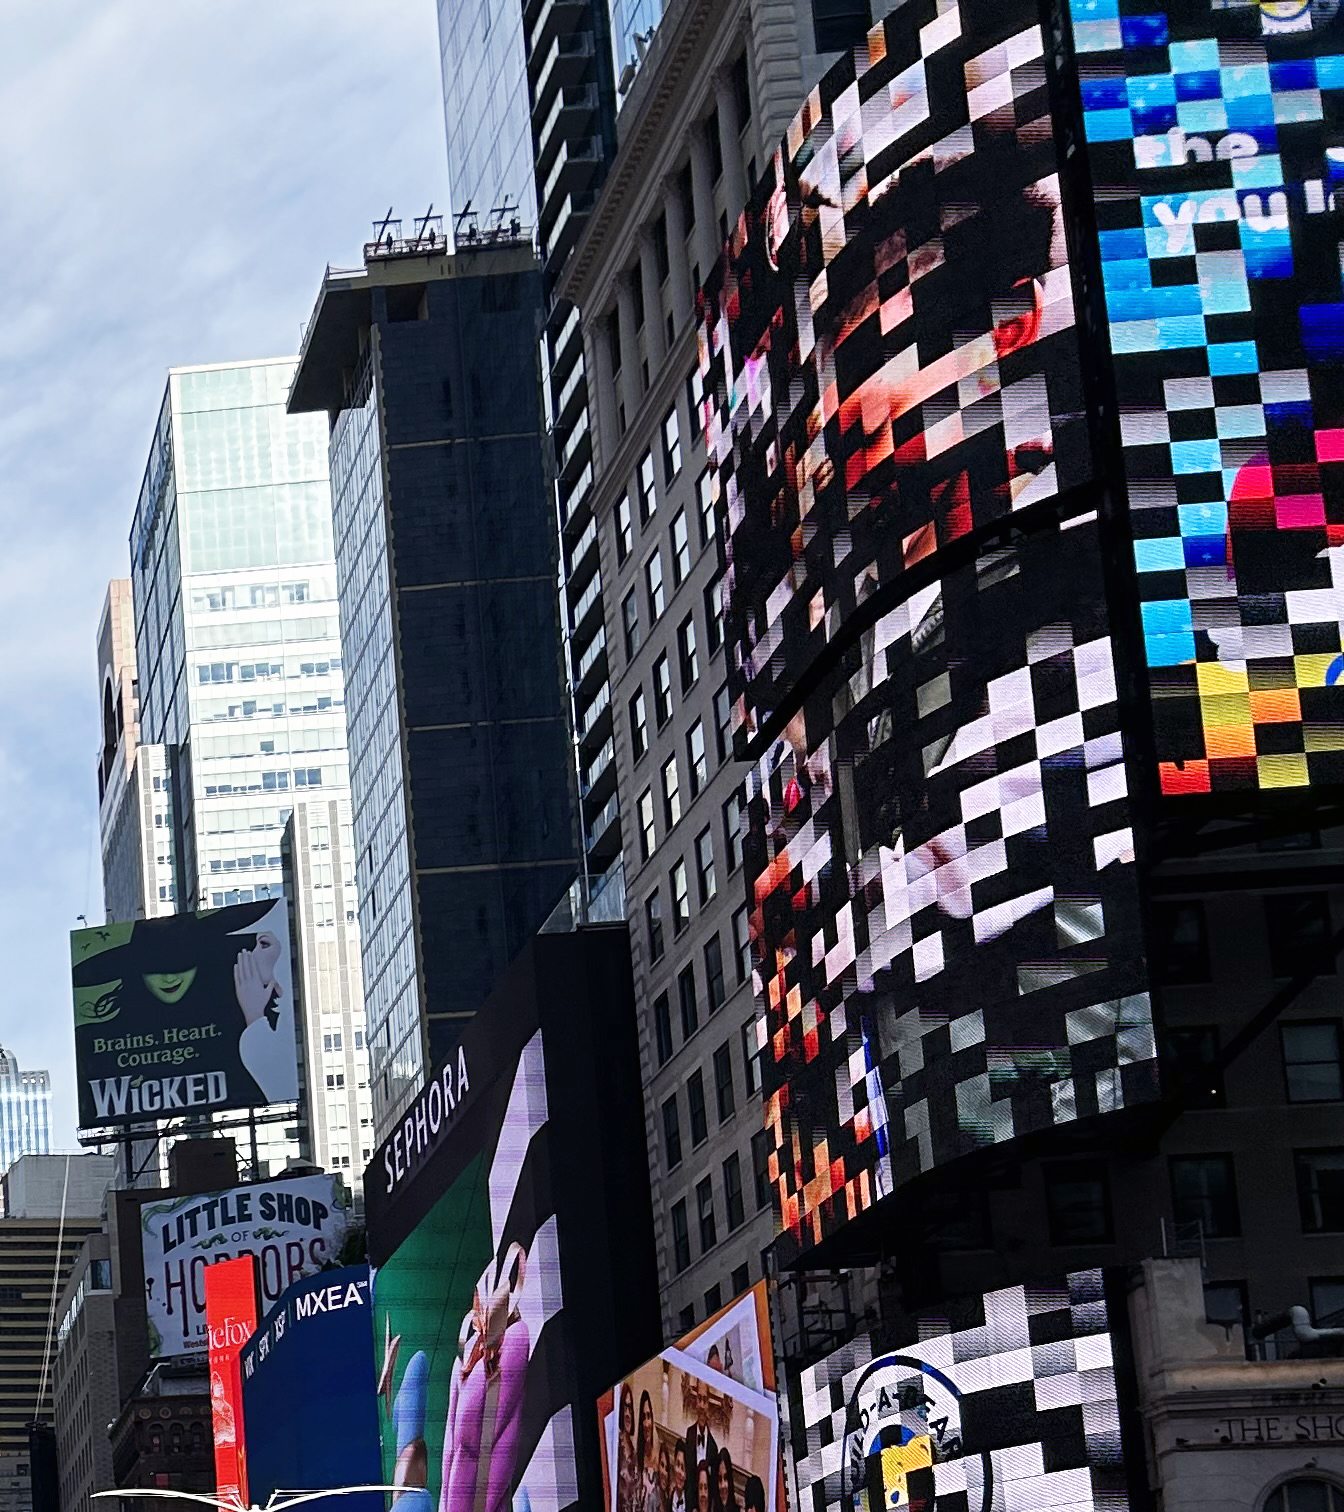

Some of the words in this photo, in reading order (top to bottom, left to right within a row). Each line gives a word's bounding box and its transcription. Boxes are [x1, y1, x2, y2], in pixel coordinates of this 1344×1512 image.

[93, 1034, 159, 1054] Brains.
[163, 1023, 222, 1044] Heart.
[117, 1046, 199, 1068] Courage.
[385, 1046, 469, 1194] SEPHORA
[162, 1192, 253, 1254] LITTLE
[259, 1192, 329, 1230] SHOP
[231, 1231, 249, 1242] OF
[296, 1282, 364, 1320] MXEA
[1220, 1417, 1283, 1441] THE
